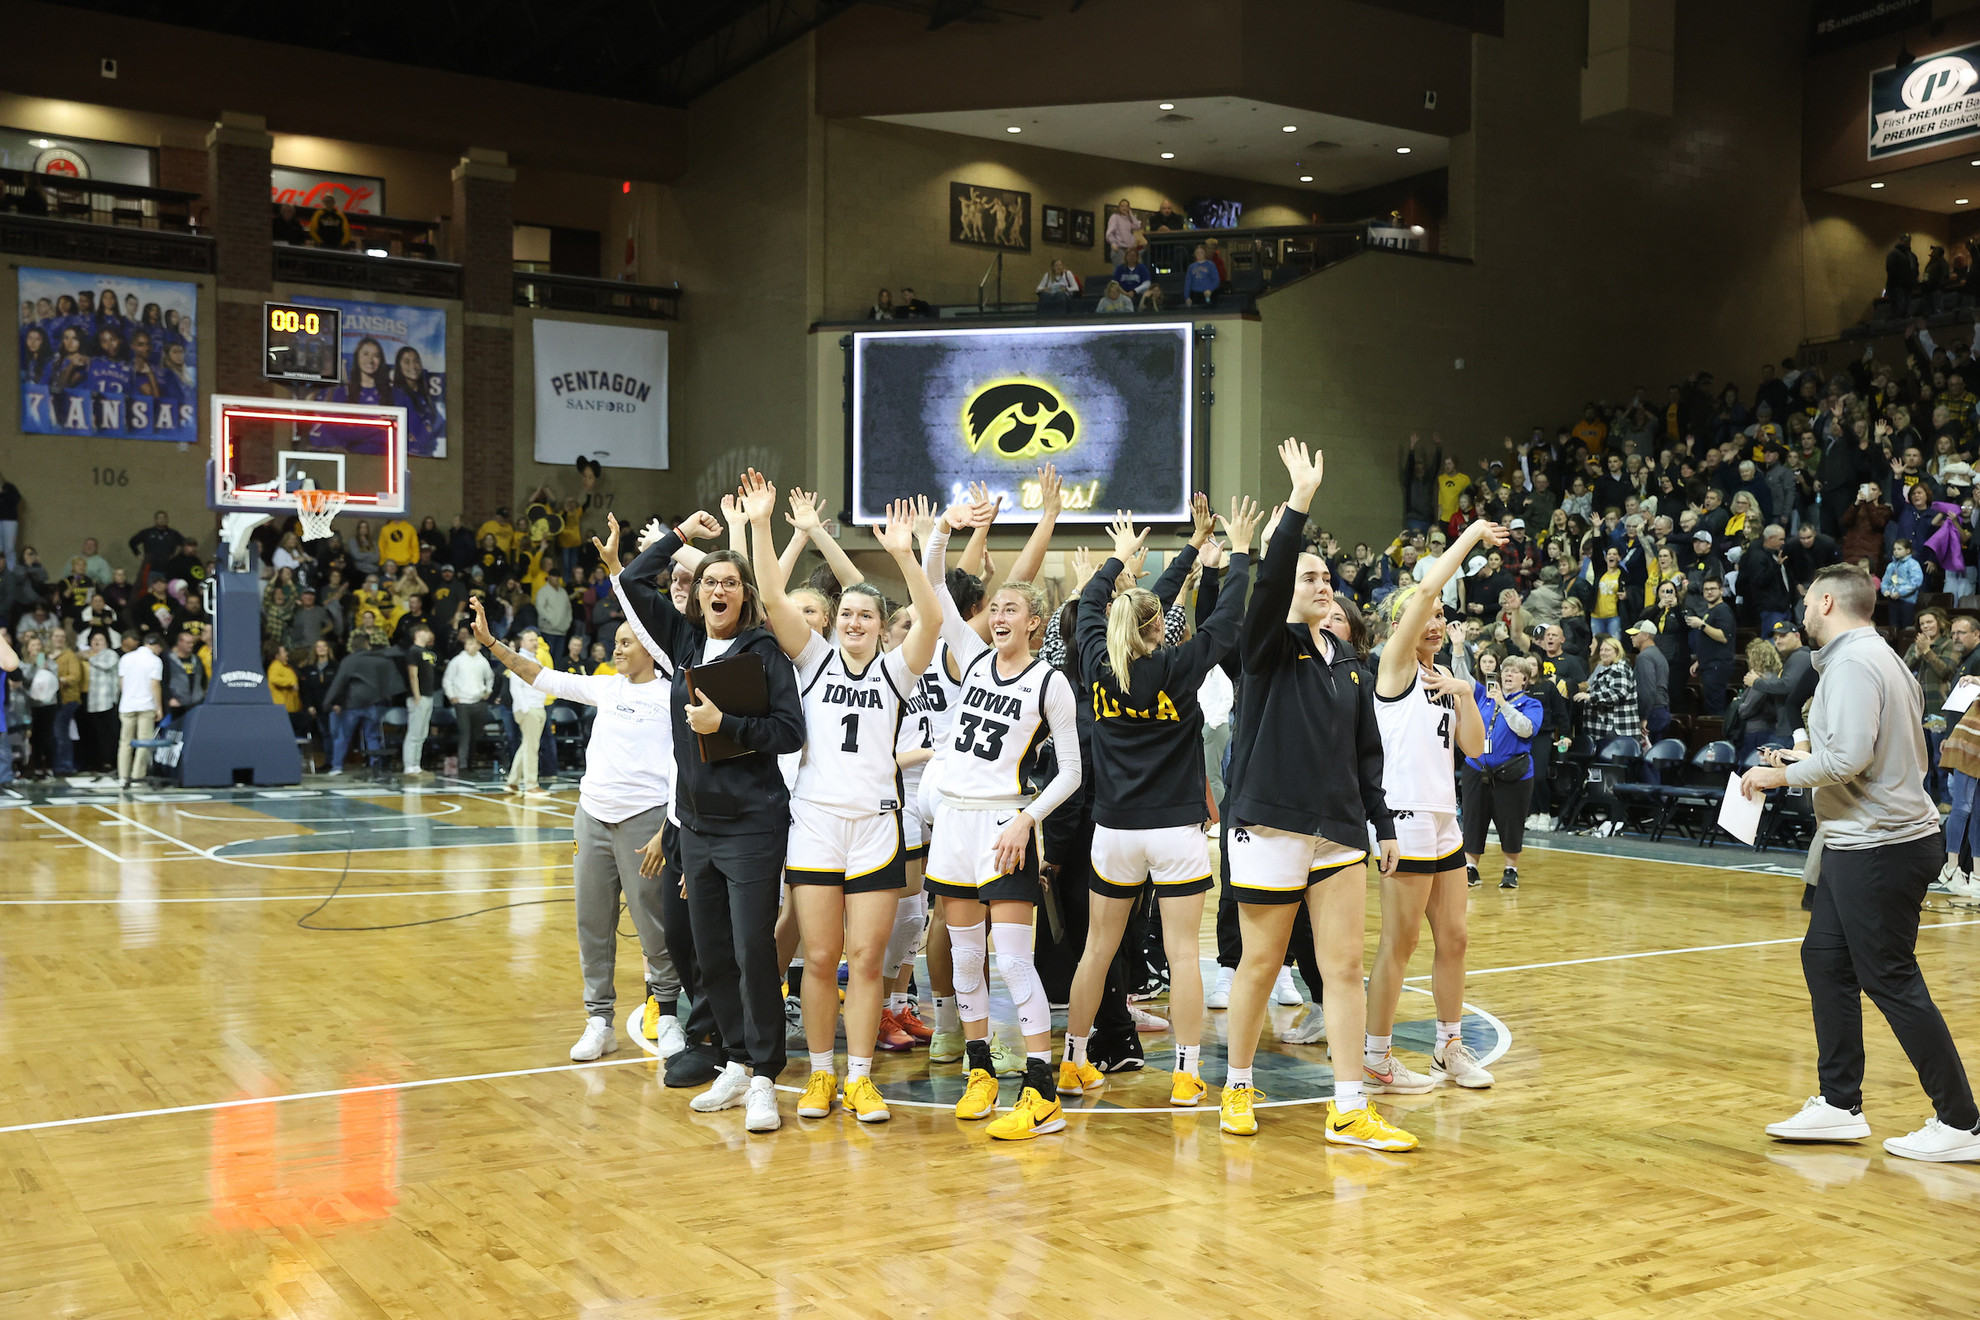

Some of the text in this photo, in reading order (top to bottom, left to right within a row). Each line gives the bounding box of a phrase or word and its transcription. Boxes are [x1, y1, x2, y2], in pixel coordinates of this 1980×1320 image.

[1882, 116, 1905, 130] First
[1908, 101, 1962, 123] PREMIER
[1883, 122, 1936, 143] PREMIER
[551, 370, 651, 402] PENTAGON
[566, 398, 636, 414] SANFORD
[93, 466, 128, 487] 106
[822, 684, 884, 709] IOWA
[963, 686, 1022, 720] IOWA
[841, 713, 859, 753] 1
[955, 712, 1010, 761] 33
[1437, 713, 1449, 749] 4
